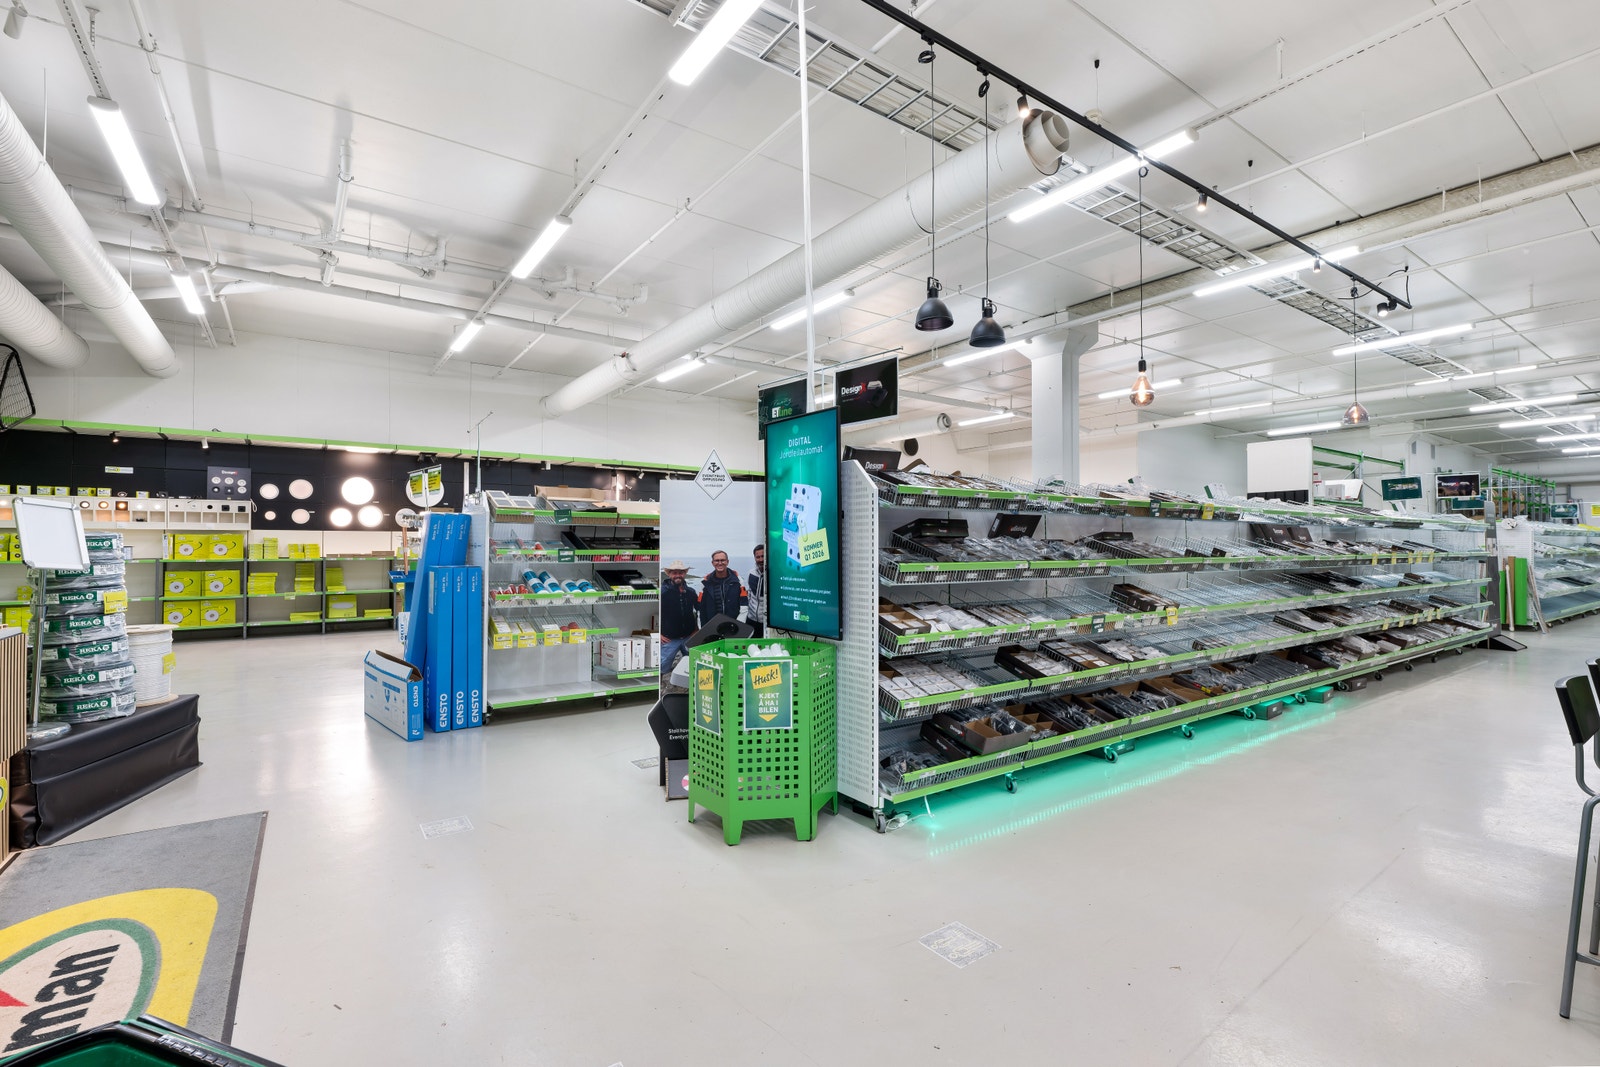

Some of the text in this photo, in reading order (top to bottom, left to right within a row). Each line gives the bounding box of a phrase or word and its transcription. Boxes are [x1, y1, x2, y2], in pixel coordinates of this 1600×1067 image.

[788, 436, 811, 447] DIGITAL
[803, 540, 823, 552] KOMMER
[812, 549, 825, 560] 2026
[69, 619, 92, 627] REKA
[79, 646, 103, 654] REKA
[63, 675, 87, 684] REKA
[753, 668, 779, 686] Husk!
[76, 702, 100, 710] REKA
[439, 693, 448, 728] ENSTO
[456, 691, 464, 725] ENSTO
[471, 689, 479, 723] ENSTO
